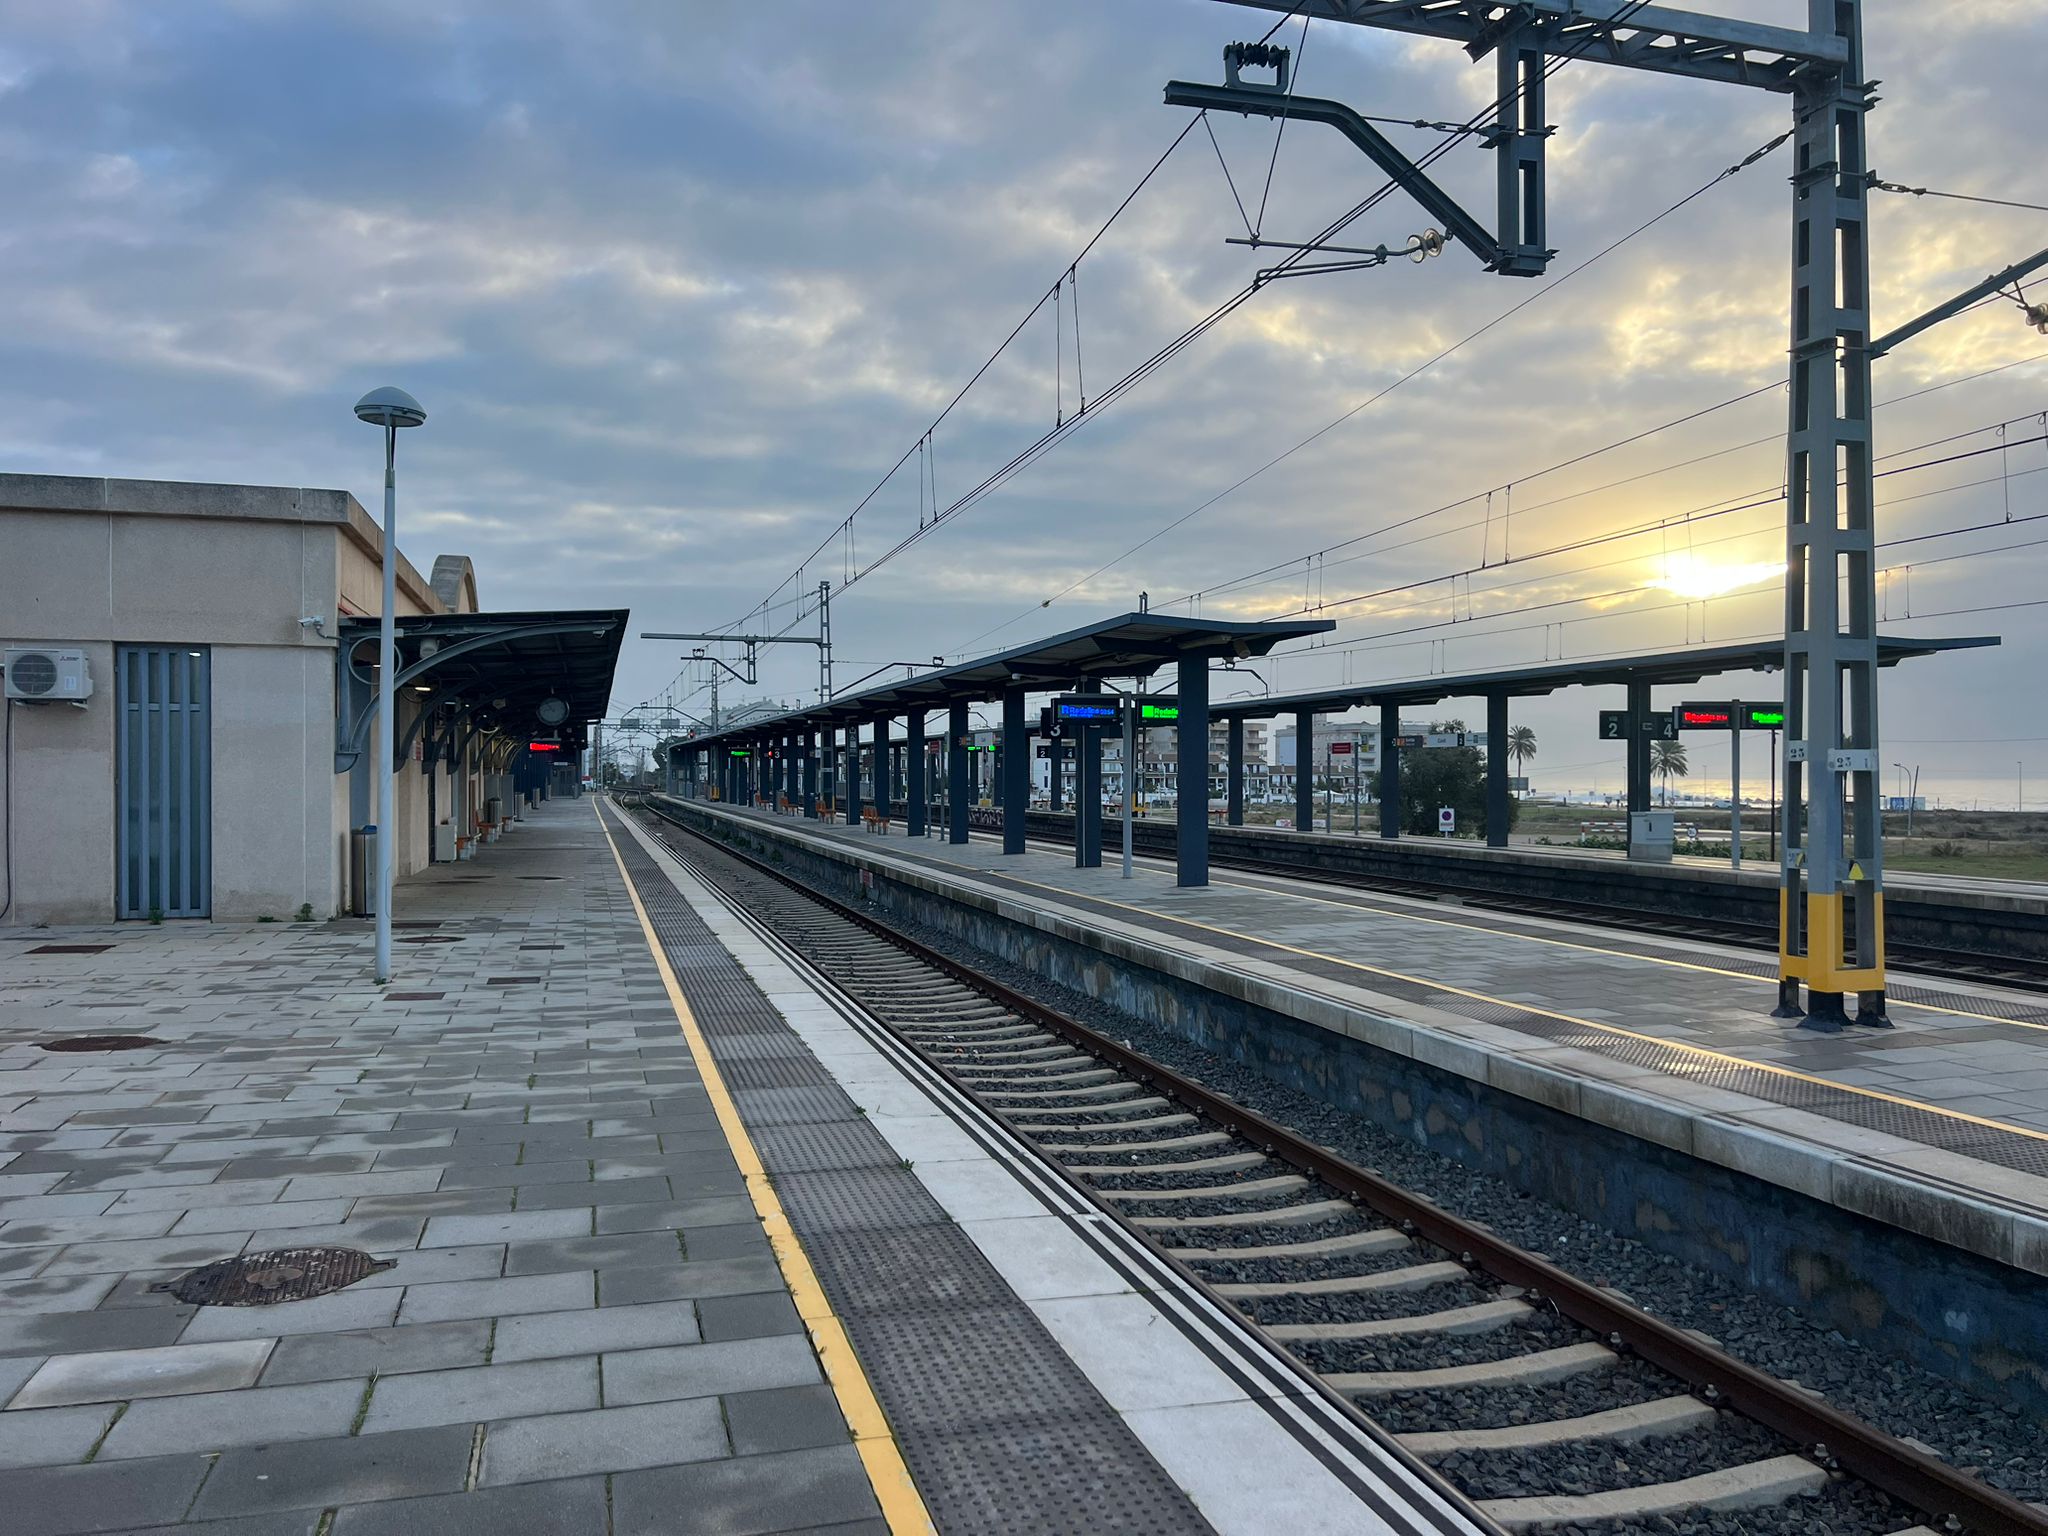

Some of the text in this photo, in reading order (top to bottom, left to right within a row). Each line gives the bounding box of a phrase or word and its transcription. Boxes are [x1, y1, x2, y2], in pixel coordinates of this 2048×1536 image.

[1050, 724, 1061, 737] 3
[1608, 722, 1618, 737] 2
[1663, 723, 1673, 738] 4
[774, 751, 780, 759] 3
[1040, 750, 1046, 758] 2
